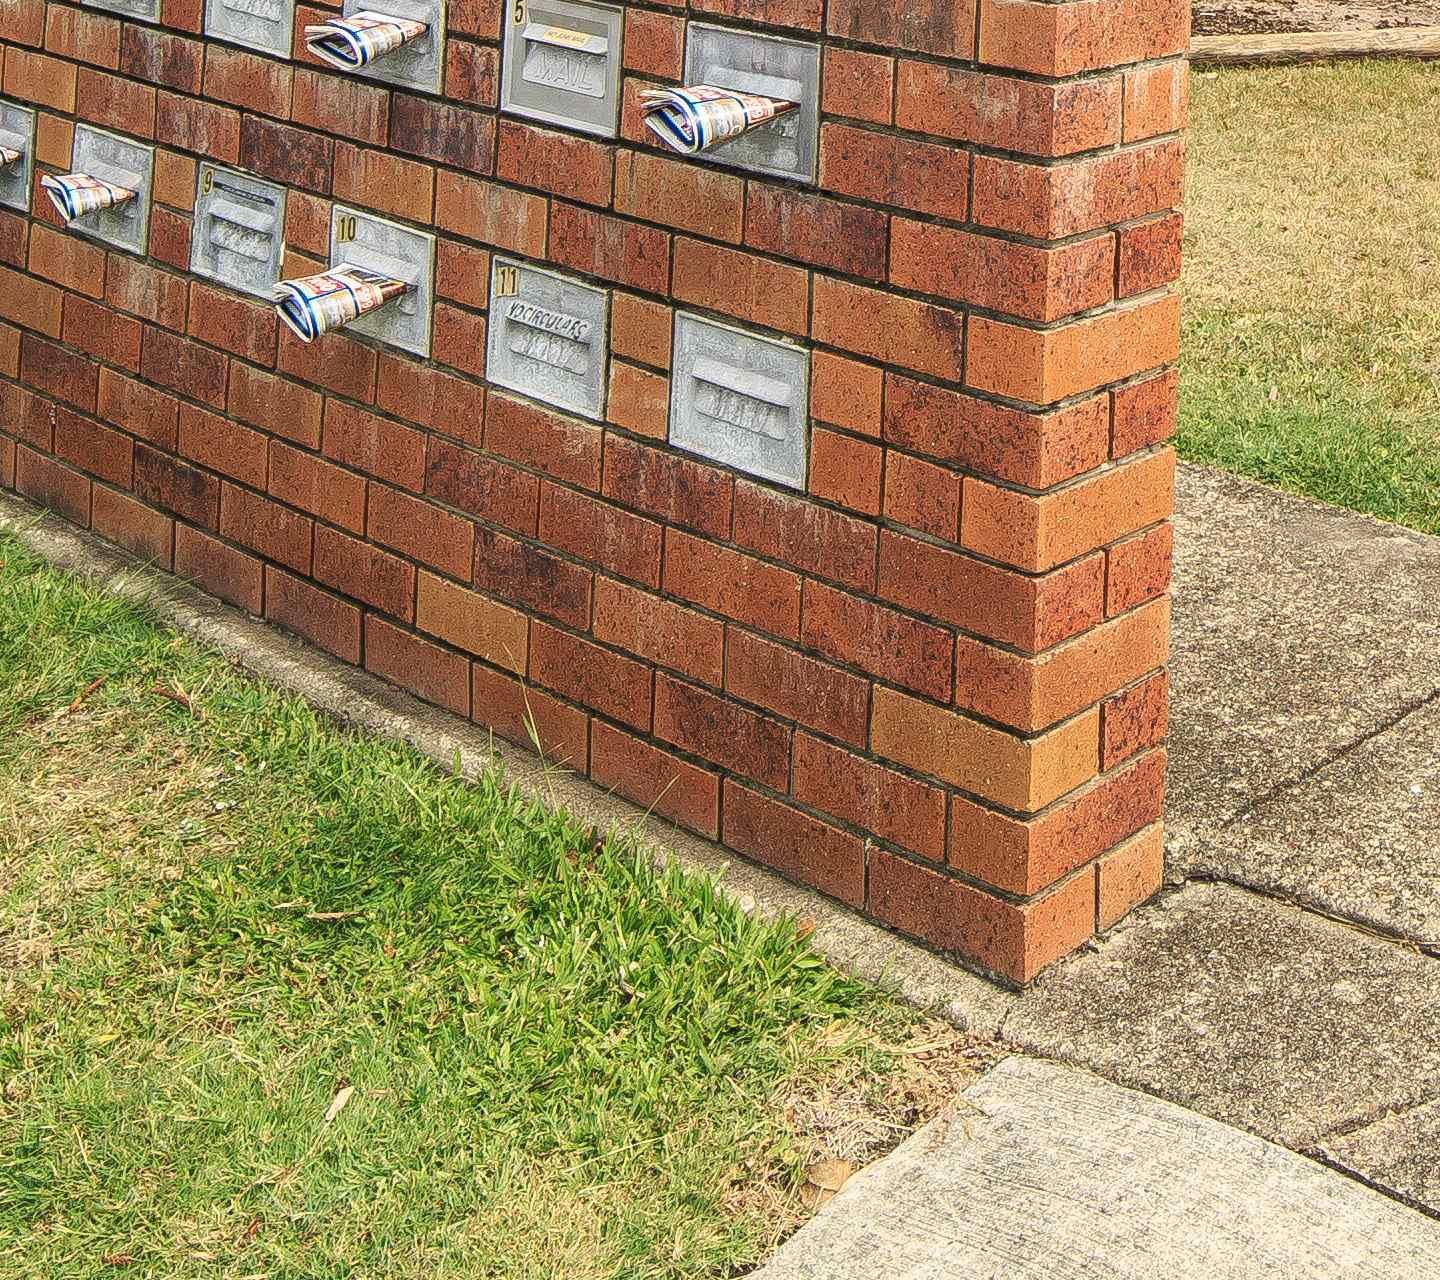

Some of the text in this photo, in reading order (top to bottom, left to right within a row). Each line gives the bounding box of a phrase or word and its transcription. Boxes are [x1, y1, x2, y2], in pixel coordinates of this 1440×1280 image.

[205, 171, 212, 193] 9
[340, 216, 356, 241] 10
[500, 268, 517, 294] 11
